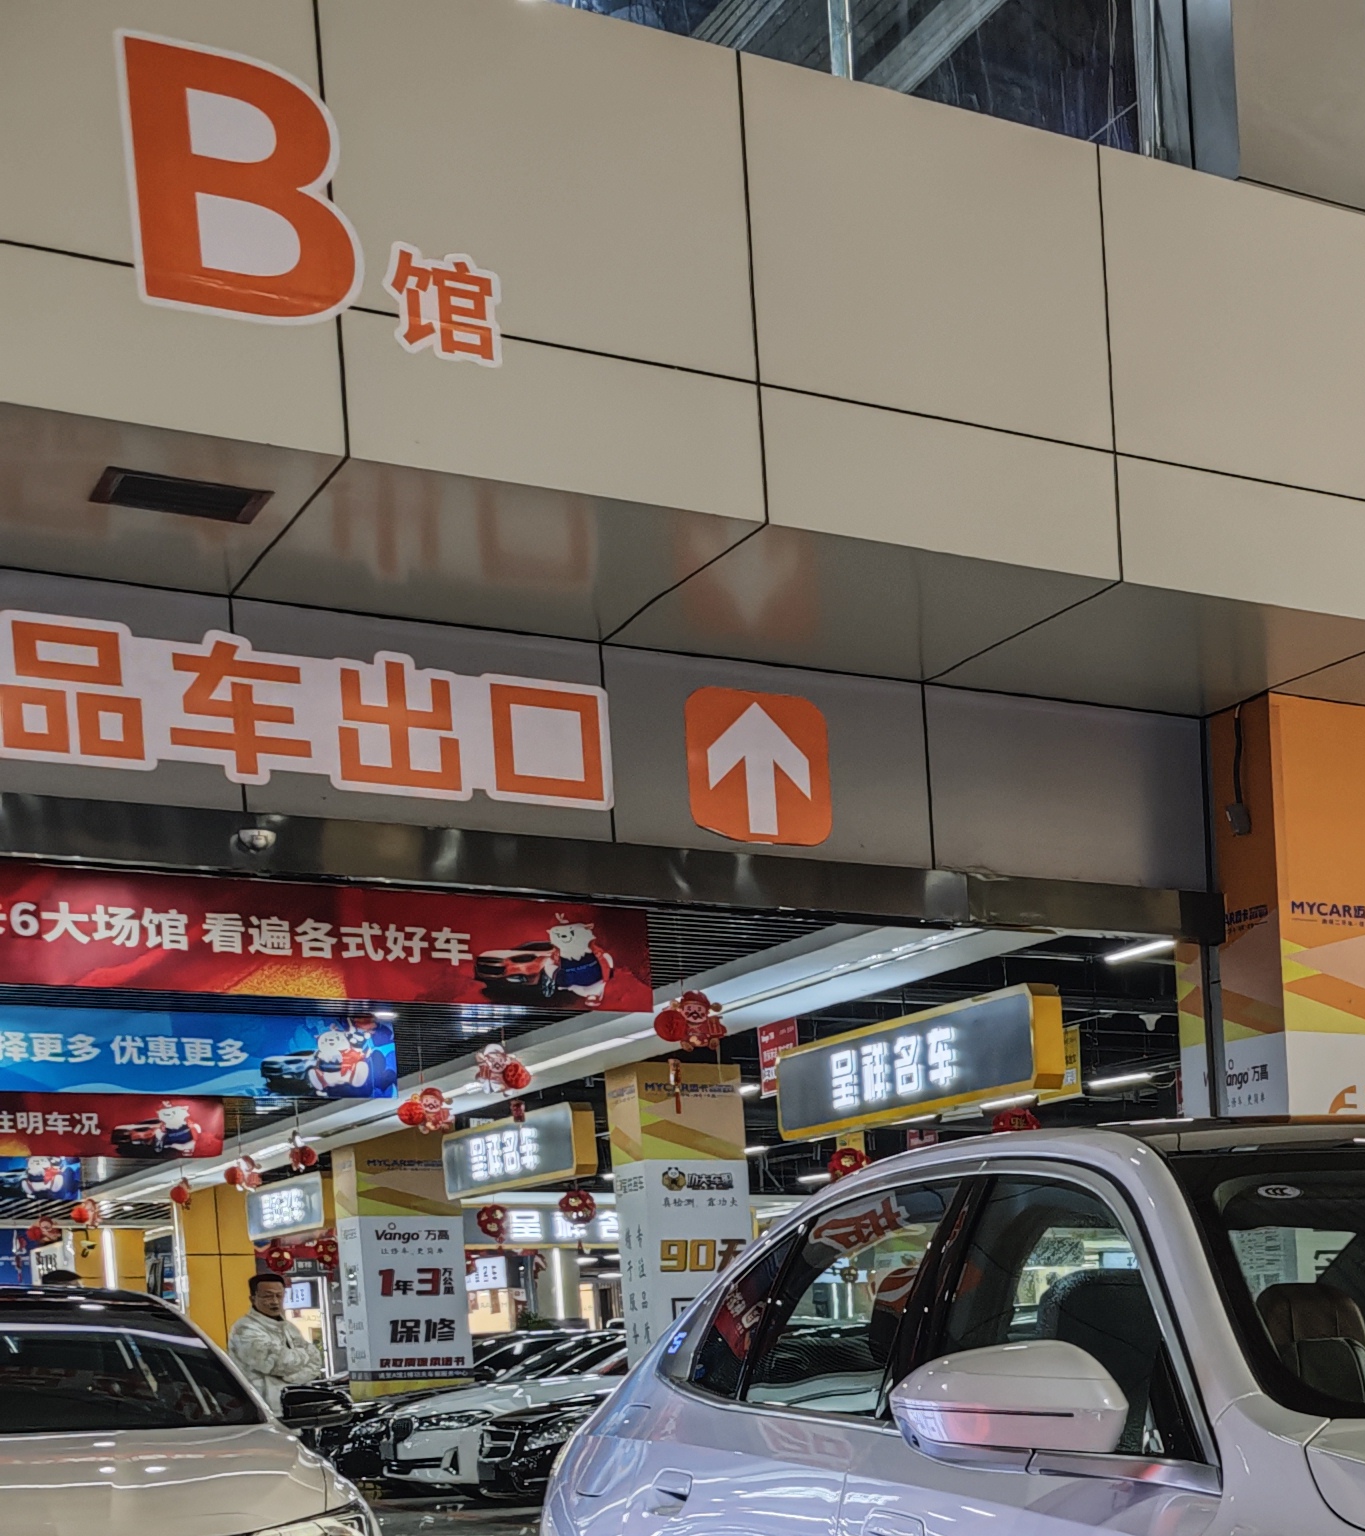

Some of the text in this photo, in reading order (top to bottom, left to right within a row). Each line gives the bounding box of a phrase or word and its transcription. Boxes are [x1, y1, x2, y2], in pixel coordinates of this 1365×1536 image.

[201, 911, 473, 966] 看遍各式好车
[110, 1034, 250, 1068] 优惠更多
[830, 1025, 958, 1111] 呈祥名车
[469, 1126, 540, 1182] 呈祥名车
[375, 1222, 420, 1244] Vango
[389, 1318, 456, 1344] 保修
